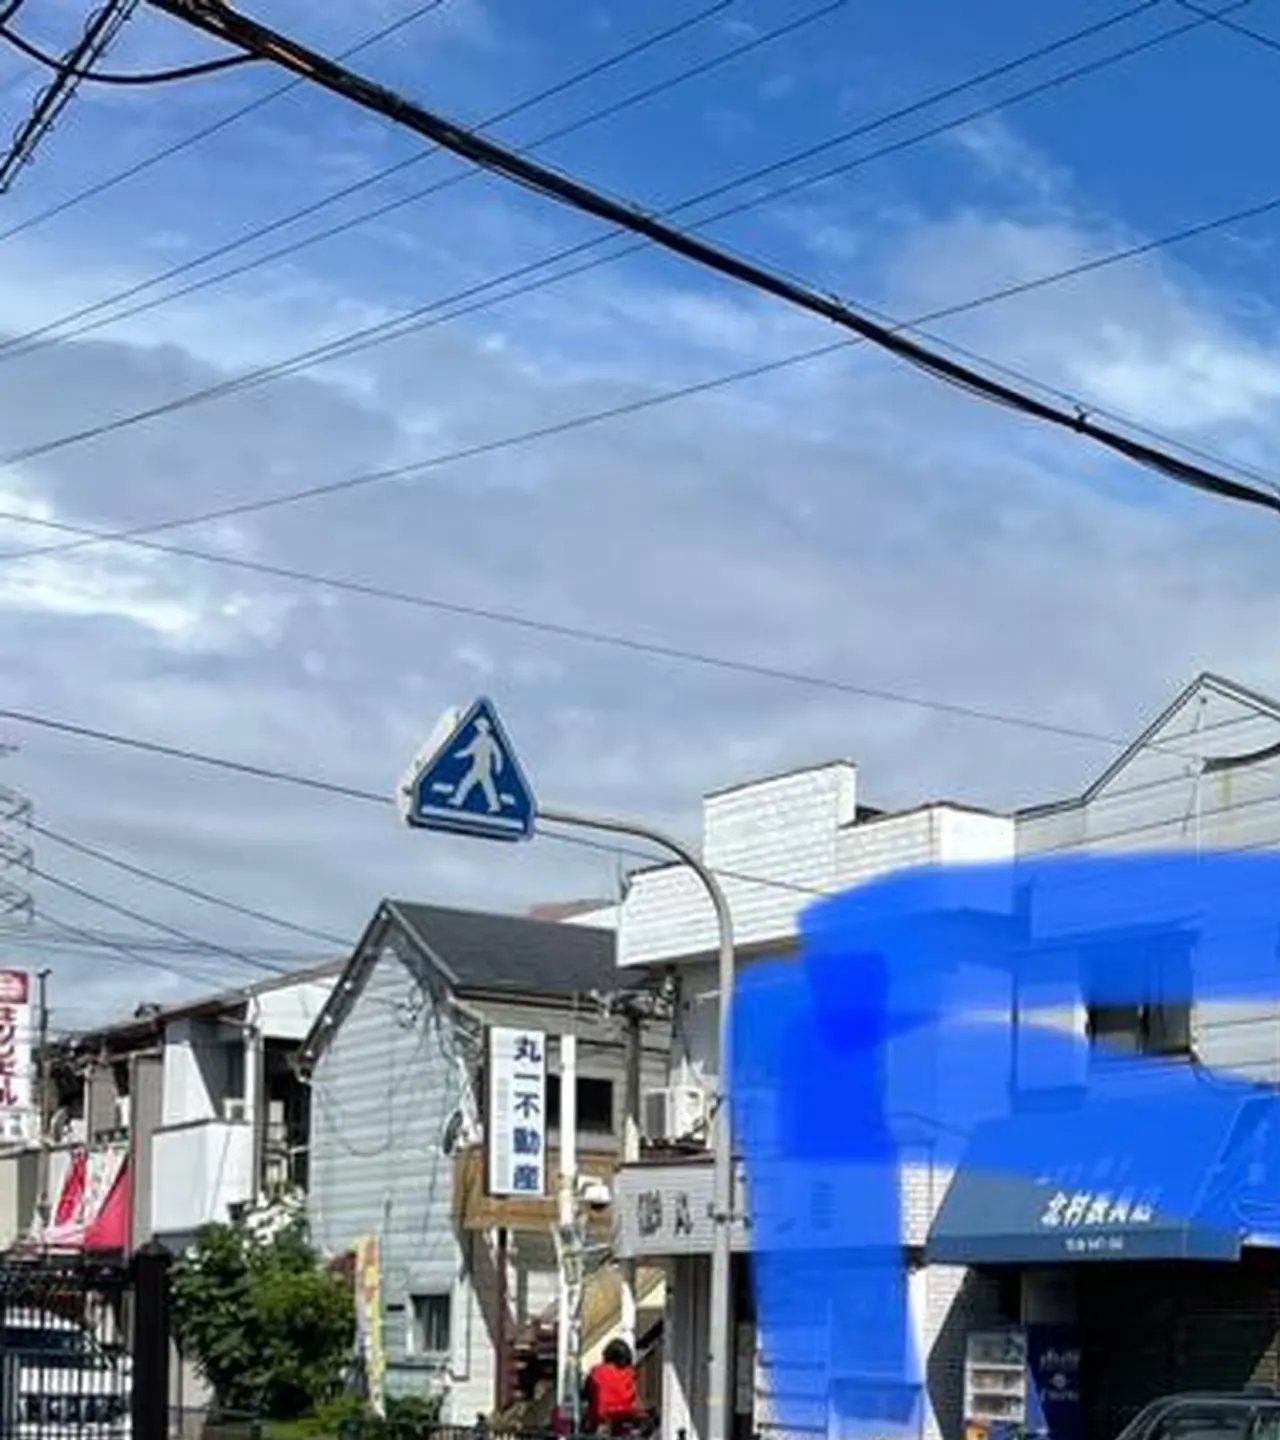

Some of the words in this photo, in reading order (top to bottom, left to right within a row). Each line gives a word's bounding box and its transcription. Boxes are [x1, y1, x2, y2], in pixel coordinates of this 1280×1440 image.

[512, 1035, 542, 1191] 丸一不動産
